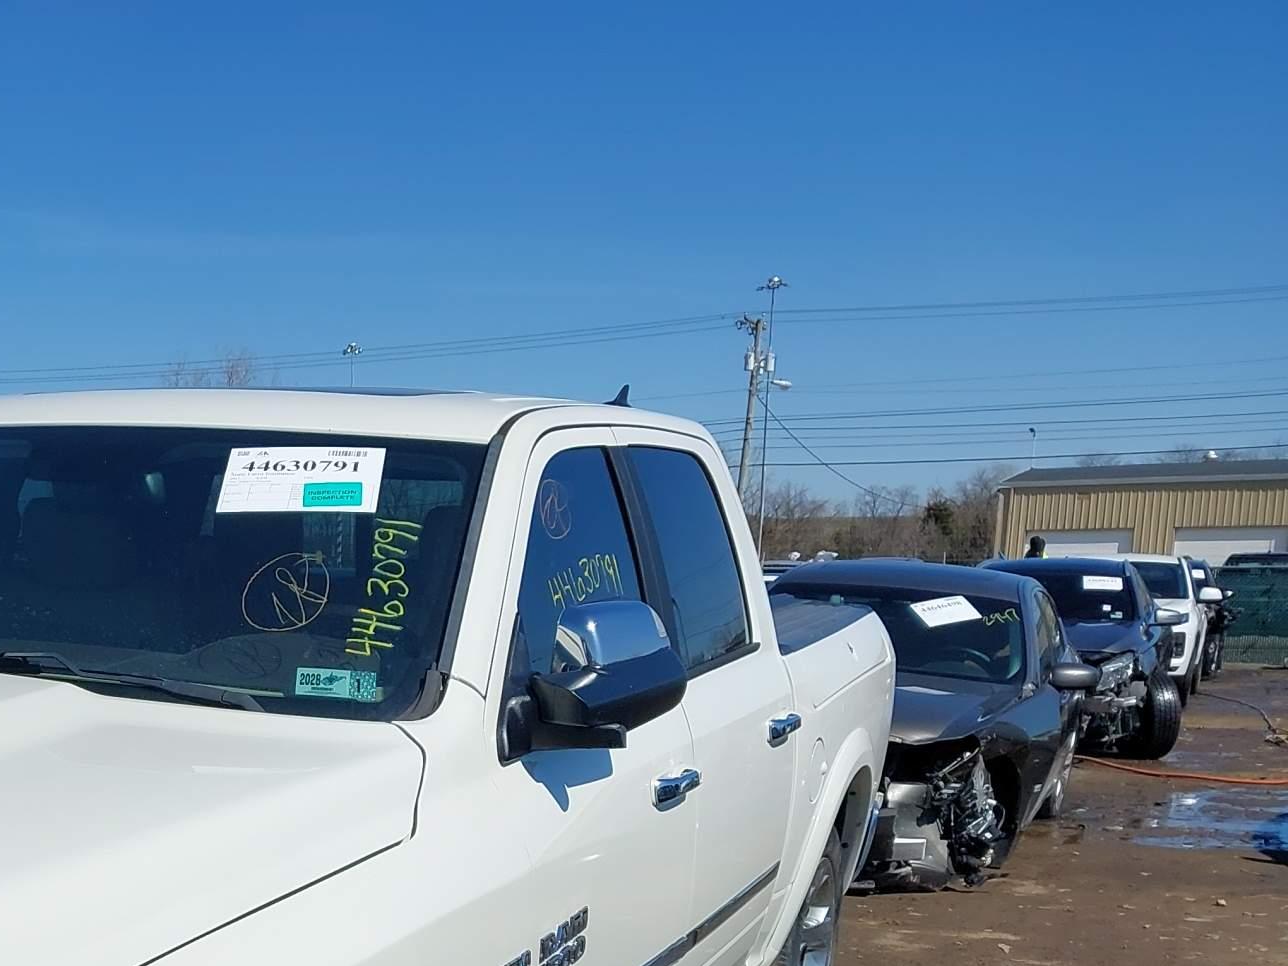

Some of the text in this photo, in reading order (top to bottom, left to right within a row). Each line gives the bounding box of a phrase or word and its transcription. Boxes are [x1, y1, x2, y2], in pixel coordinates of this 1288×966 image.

[241, 460, 361, 473] 44630791
[345, 517, 423, 656] 44630791
[548, 553, 624, 609] 44630791
[299, 673, 321, 686] 2028
